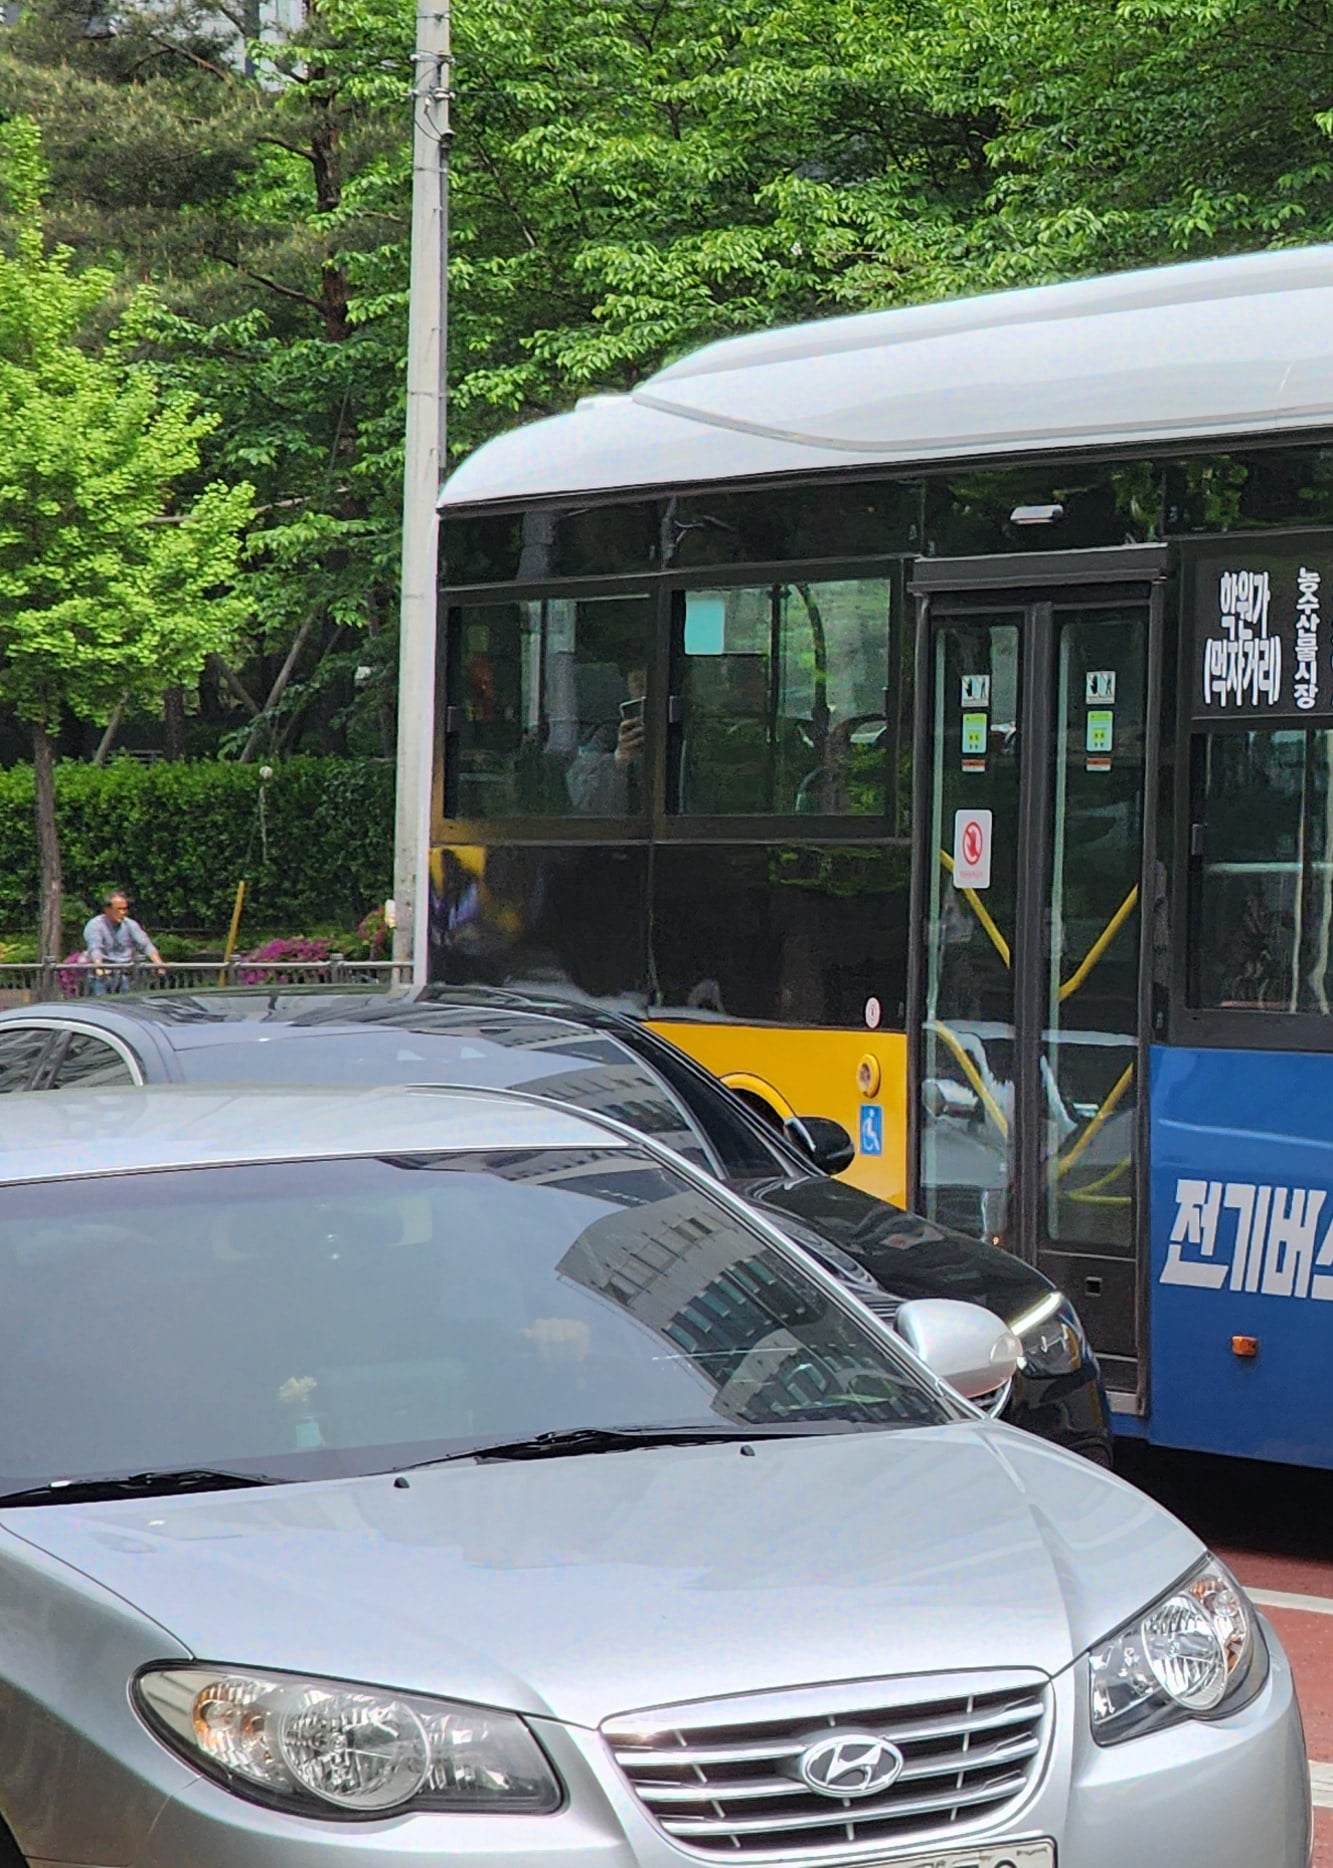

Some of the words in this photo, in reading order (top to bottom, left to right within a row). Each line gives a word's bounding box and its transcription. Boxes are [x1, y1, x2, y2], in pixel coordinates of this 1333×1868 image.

[1219, 570, 1271, 641] 학원가
[1293, 566, 1321, 709] 농수산물시장
[1204, 635, 1282, 707] (먹자거리)
